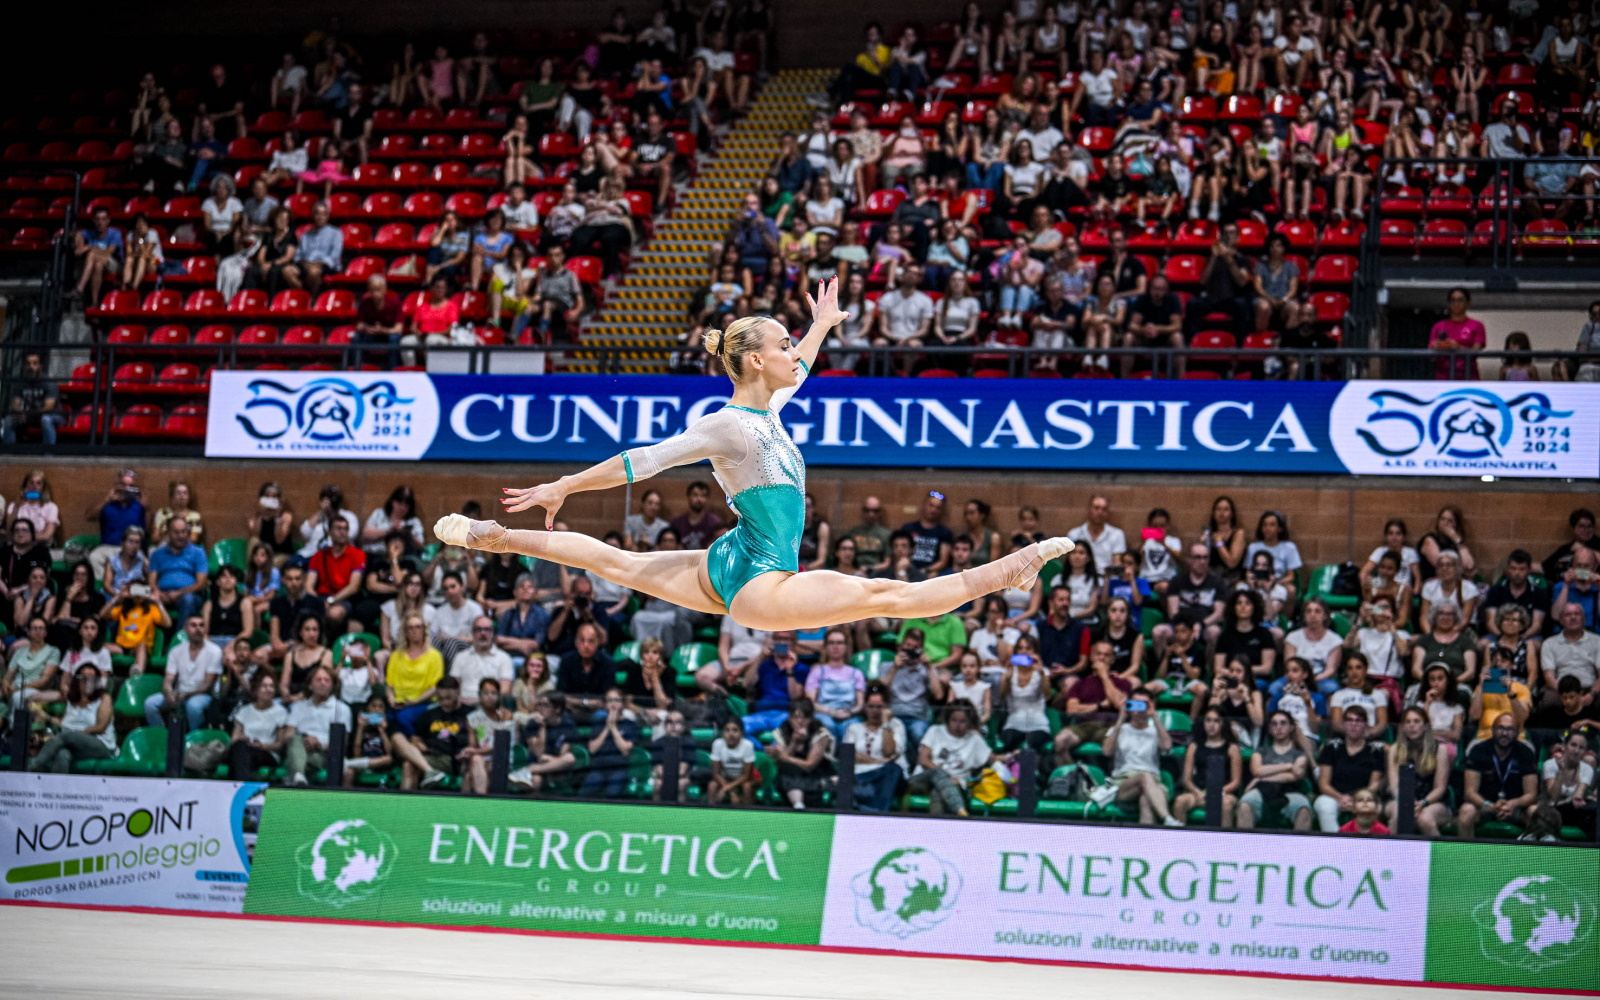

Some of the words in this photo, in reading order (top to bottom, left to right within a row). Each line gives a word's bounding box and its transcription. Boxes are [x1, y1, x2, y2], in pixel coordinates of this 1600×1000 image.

[373, 412, 411, 423] 1974
[373, 426, 411, 436] 2024
[1524, 427, 1570, 438] 1974
[1523, 441, 1570, 453] 2024
[16, 801, 198, 854] NOLOPOINT
[105, 834, 221, 871] noleggio
[14, 885, 53, 898] BORGO
[55, 882, 76, 894] SAN
[79, 873, 135, 890] DALMAZZO
[137, 870, 160, 882] (CN)
[422, 897, 501, 916] soluzioni
[510, 902, 606, 923] alternative
[615, 911, 625, 923] a
[635, 908, 697, 927] misura
[706, 911, 778, 931] d'uomo
[994, 929, 1082, 949] soluzioni
[1091, 934, 1199, 955] alternative
[1209, 944, 1220, 955] a
[1231, 941, 1299, 960] misura
[1310, 943, 1390, 964] d'uomo
